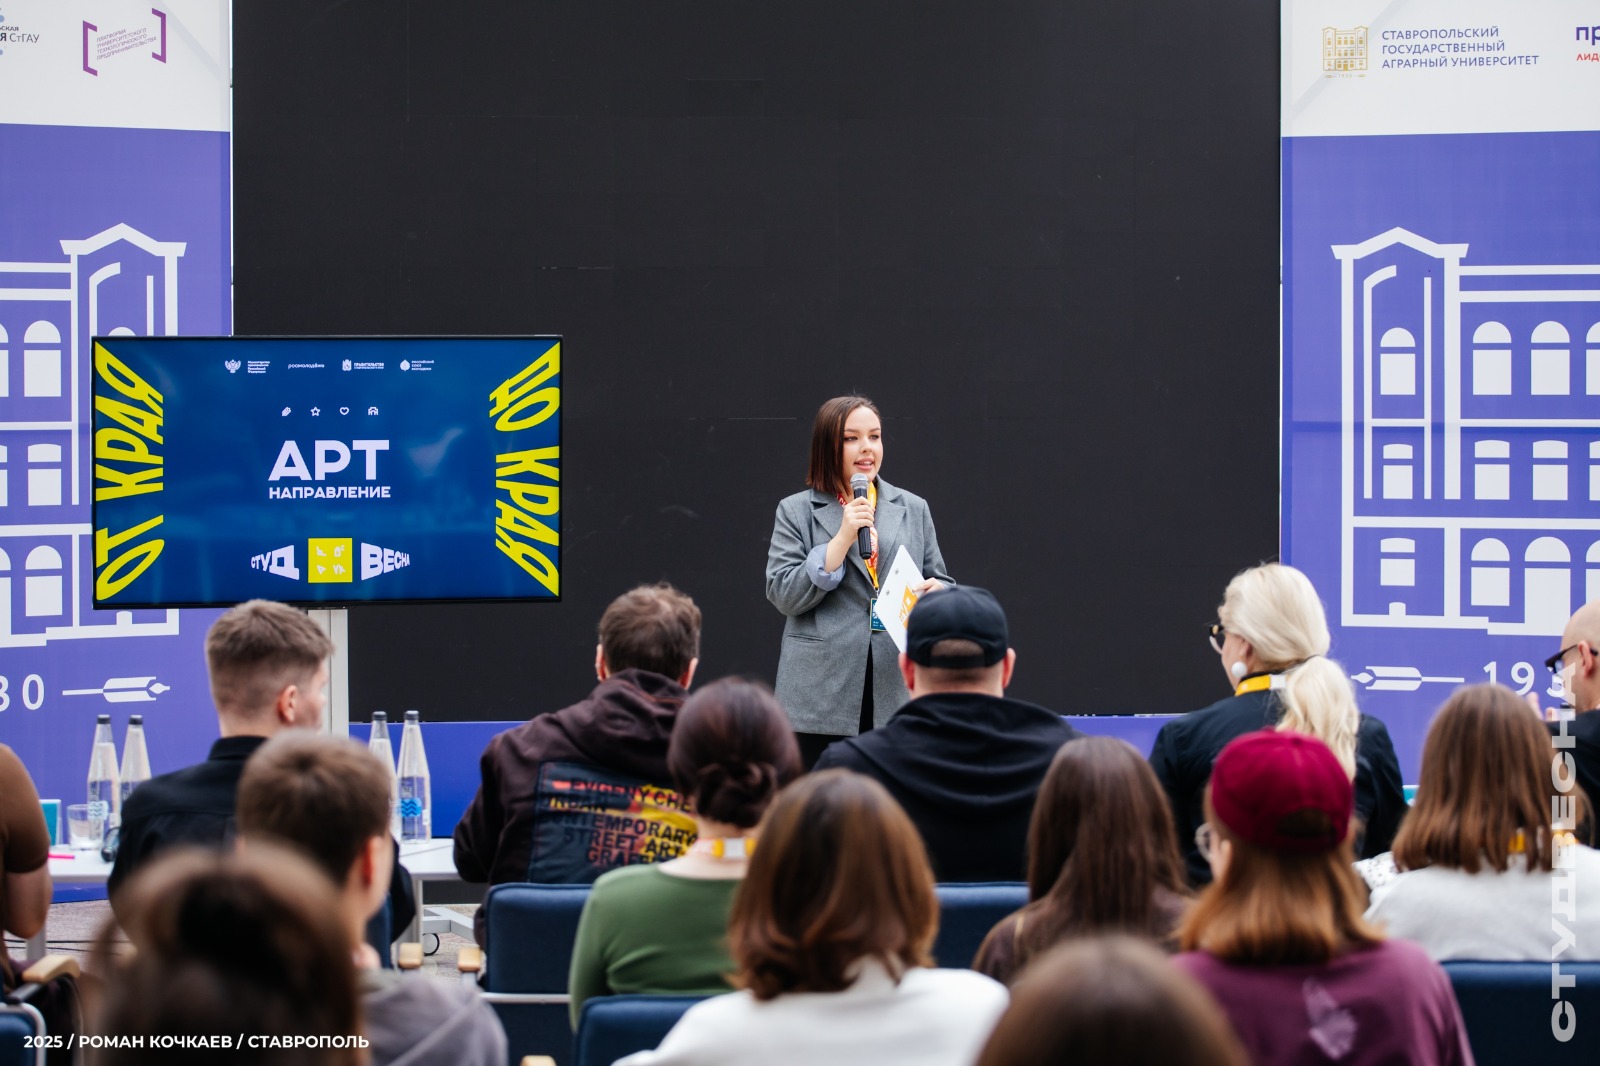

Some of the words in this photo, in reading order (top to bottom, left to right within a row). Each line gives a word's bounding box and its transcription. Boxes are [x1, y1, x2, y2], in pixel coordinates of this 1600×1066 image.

[97, 29, 126, 42] ПЛАТФОРМА
[1382, 26, 1499, 40] СТАВРОПОЛЬСКИЙ
[1382, 42, 1505, 55] ГОСУДАРСТВЕННЫЙ
[1576, 53, 1600, 62] лид
[1382, 57, 1448, 69] АГРАРНЫЙ
[1451, 55, 1539, 68] УНИВЕРСИТЕТ
[489, 341, 560, 432] ДО
[95, 341, 164, 501] КРАЯ
[268, 440, 390, 481] АРТ
[268, 486, 391, 500] НАПРАВЛЕНИЕ
[495, 446, 560, 598] КРАЯ
[95, 515, 164, 600] ОТ
[251, 545, 300, 581] СТУД
[361, 542, 411, 581] ВЕСНА
[563, 826, 638, 851] STREET
